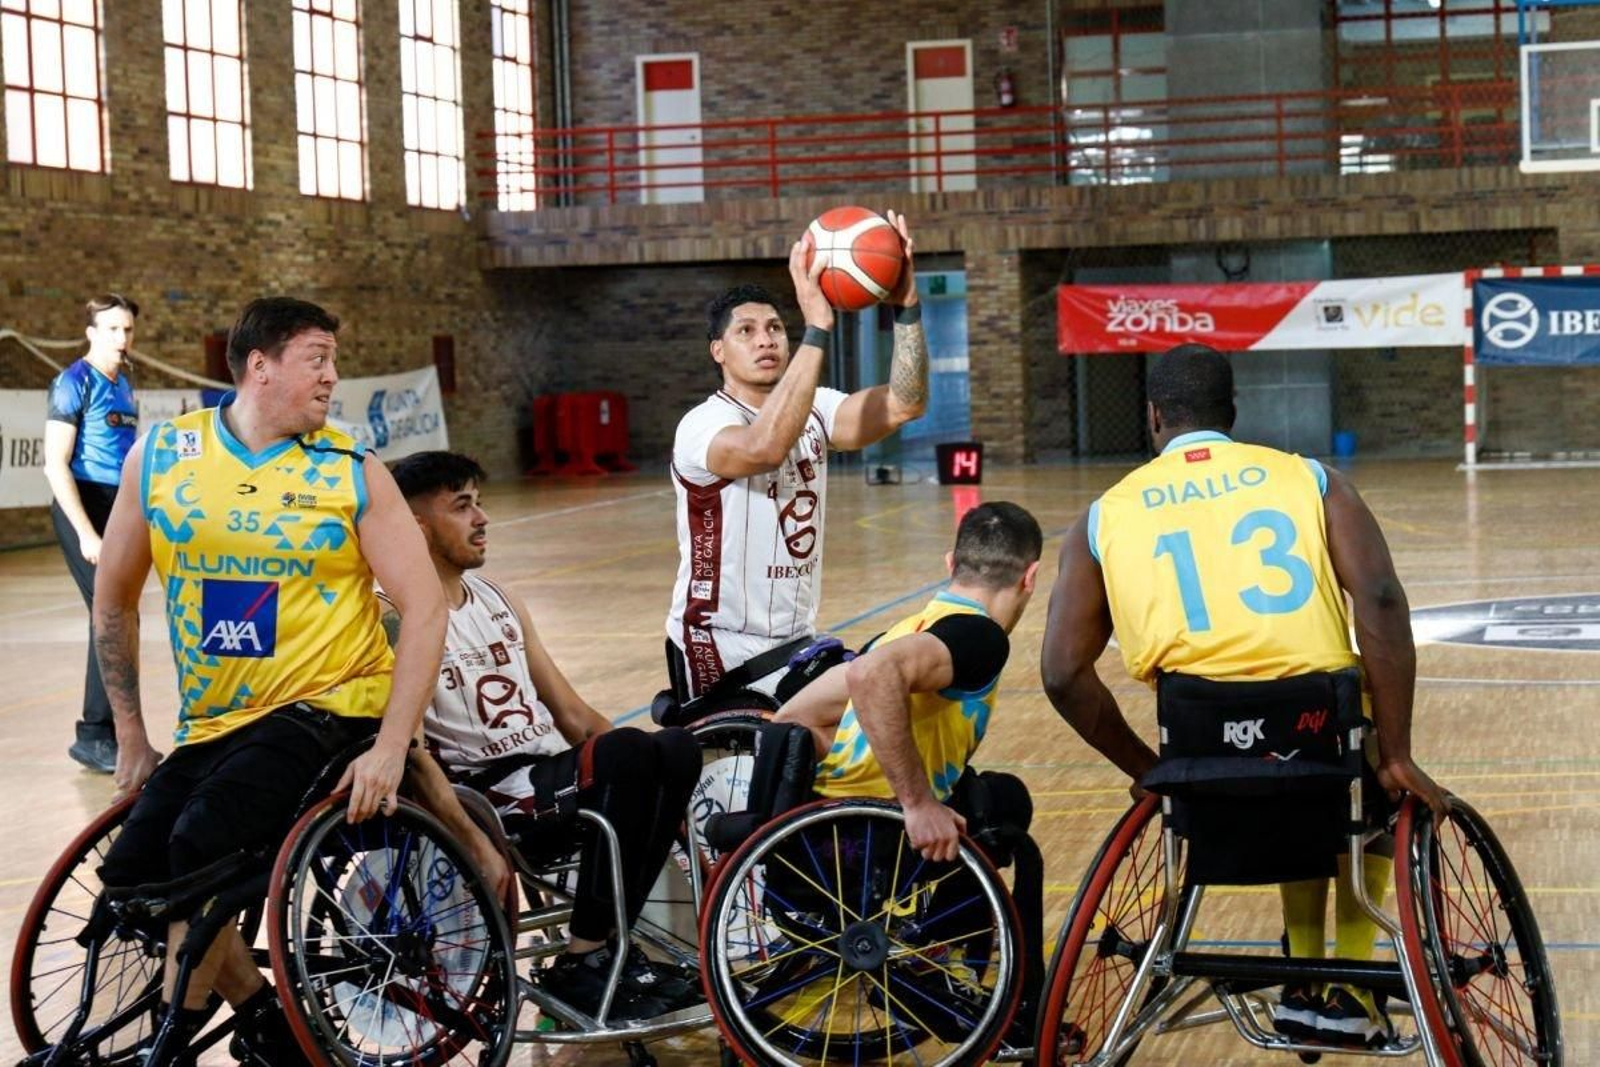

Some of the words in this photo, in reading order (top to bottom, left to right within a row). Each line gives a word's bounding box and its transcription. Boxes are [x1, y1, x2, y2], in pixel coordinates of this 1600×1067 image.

[1107, 294, 1178, 313] viaxes
[1106, 310, 1215, 333] zonda
[953, 451, 978, 477] 14
[1142, 466, 1267, 509] DIALLO
[226, 510, 261, 533] 35
[703, 508, 715, 559] GALICIA
[176, 552, 315, 578] ILUNION
[694, 533, 704, 577] XUNTA
[703, 561, 715, 577] DE
[1153, 508, 1314, 633] 13
[202, 619, 263, 652] AXA
[441, 666, 464, 690] 31
